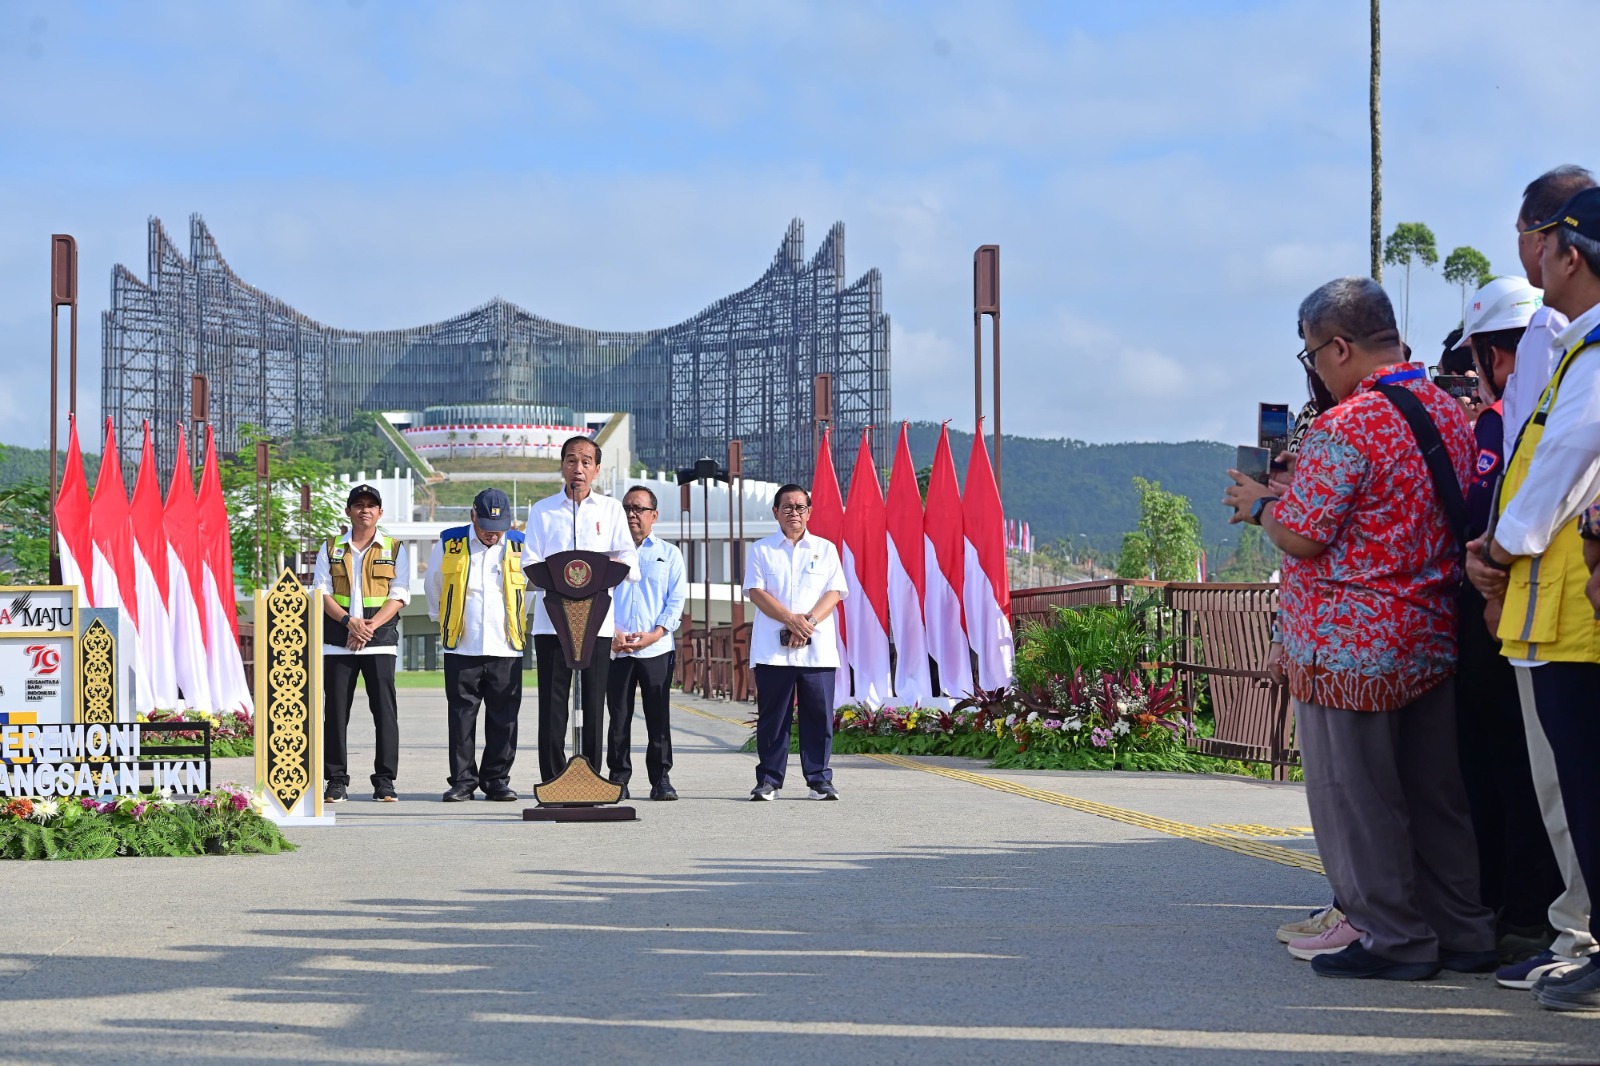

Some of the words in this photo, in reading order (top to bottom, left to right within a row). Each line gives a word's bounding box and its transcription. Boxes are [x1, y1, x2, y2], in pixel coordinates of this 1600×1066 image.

[22, 607, 73, 631] MAJU
[23, 645, 60, 676] 79
[0, 723, 141, 758] EREMONI
[153, 761, 206, 795] IKN
